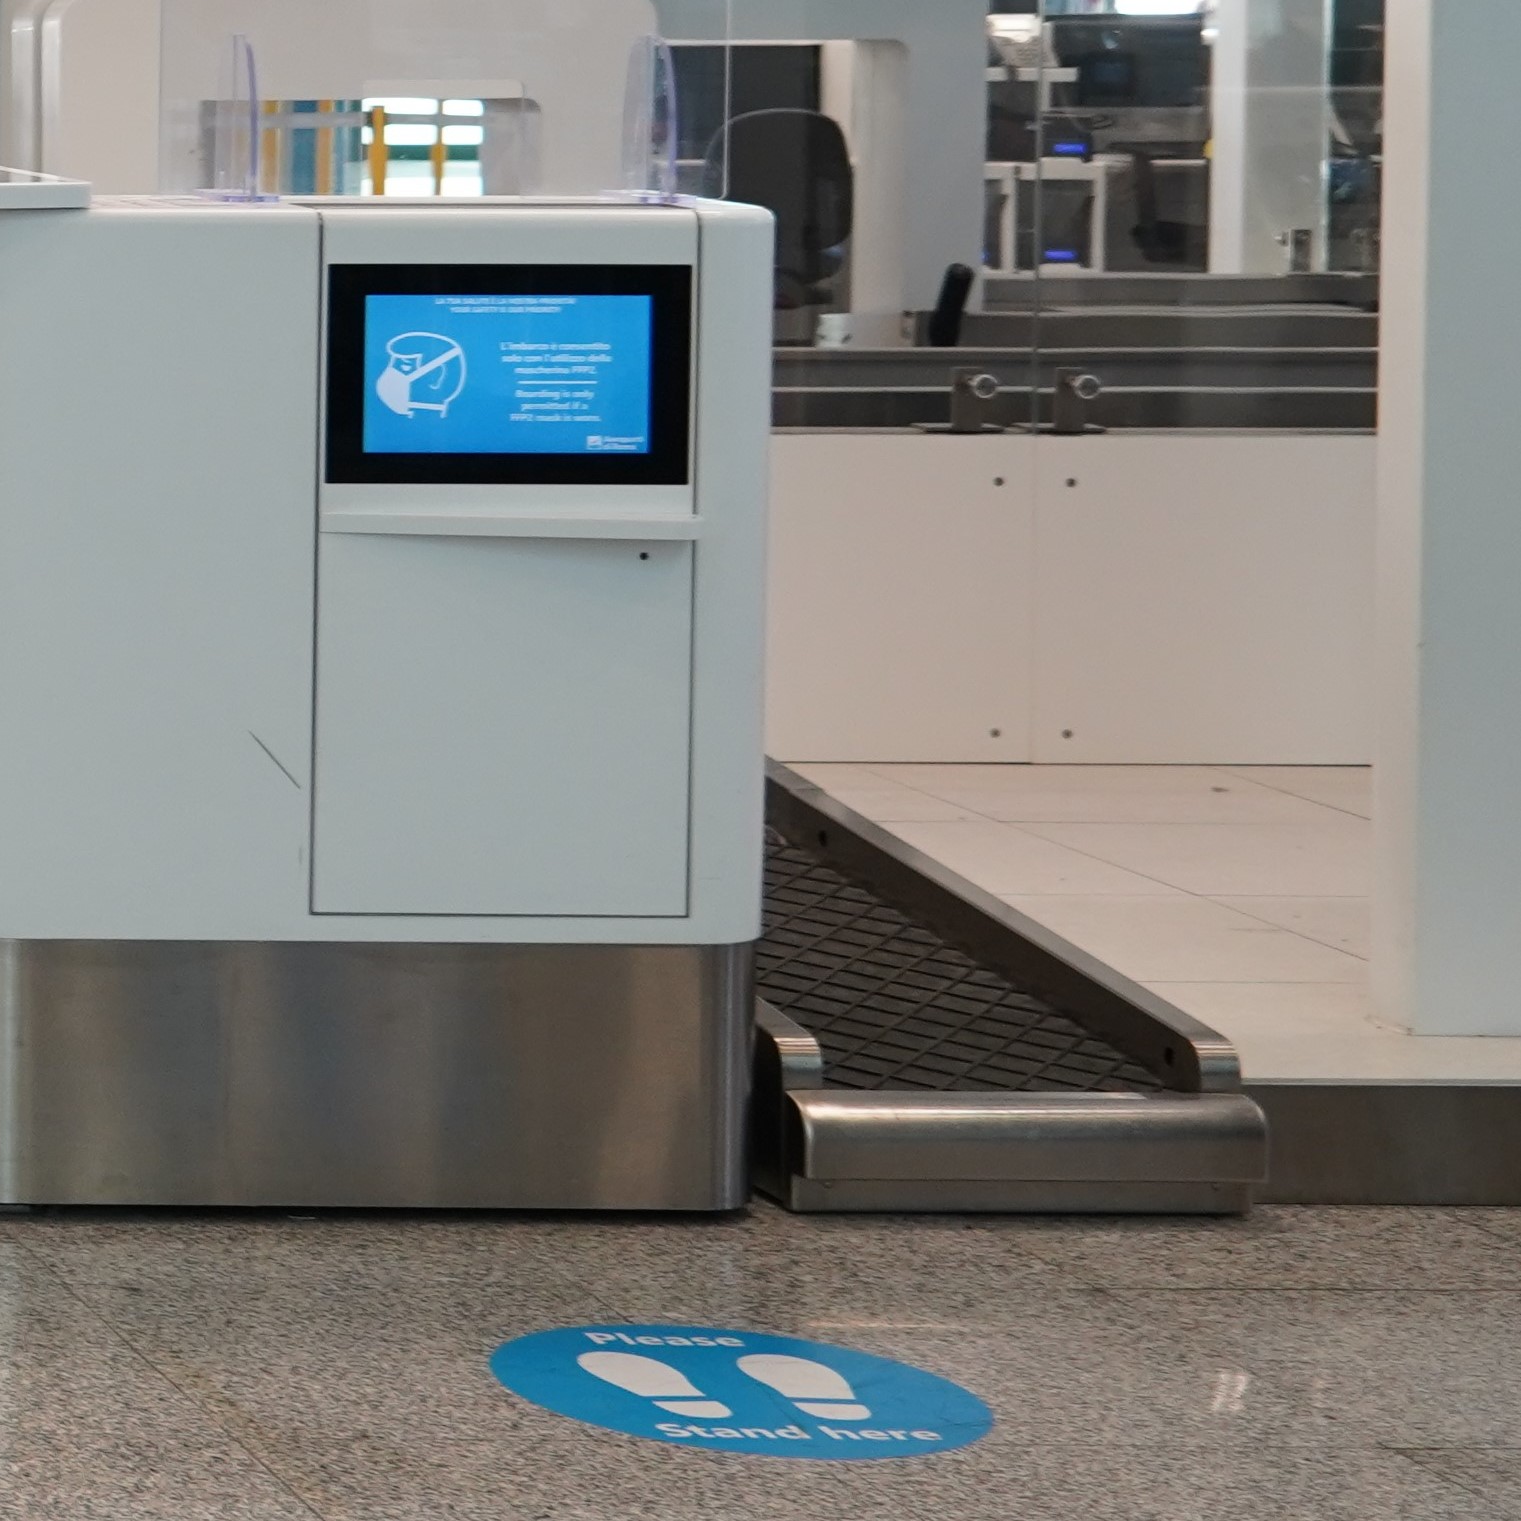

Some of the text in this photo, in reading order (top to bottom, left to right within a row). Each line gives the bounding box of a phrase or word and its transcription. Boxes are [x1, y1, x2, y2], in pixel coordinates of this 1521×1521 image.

[584, 1331, 746, 1349] Please
[656, 1422, 944, 1442] Stand here
